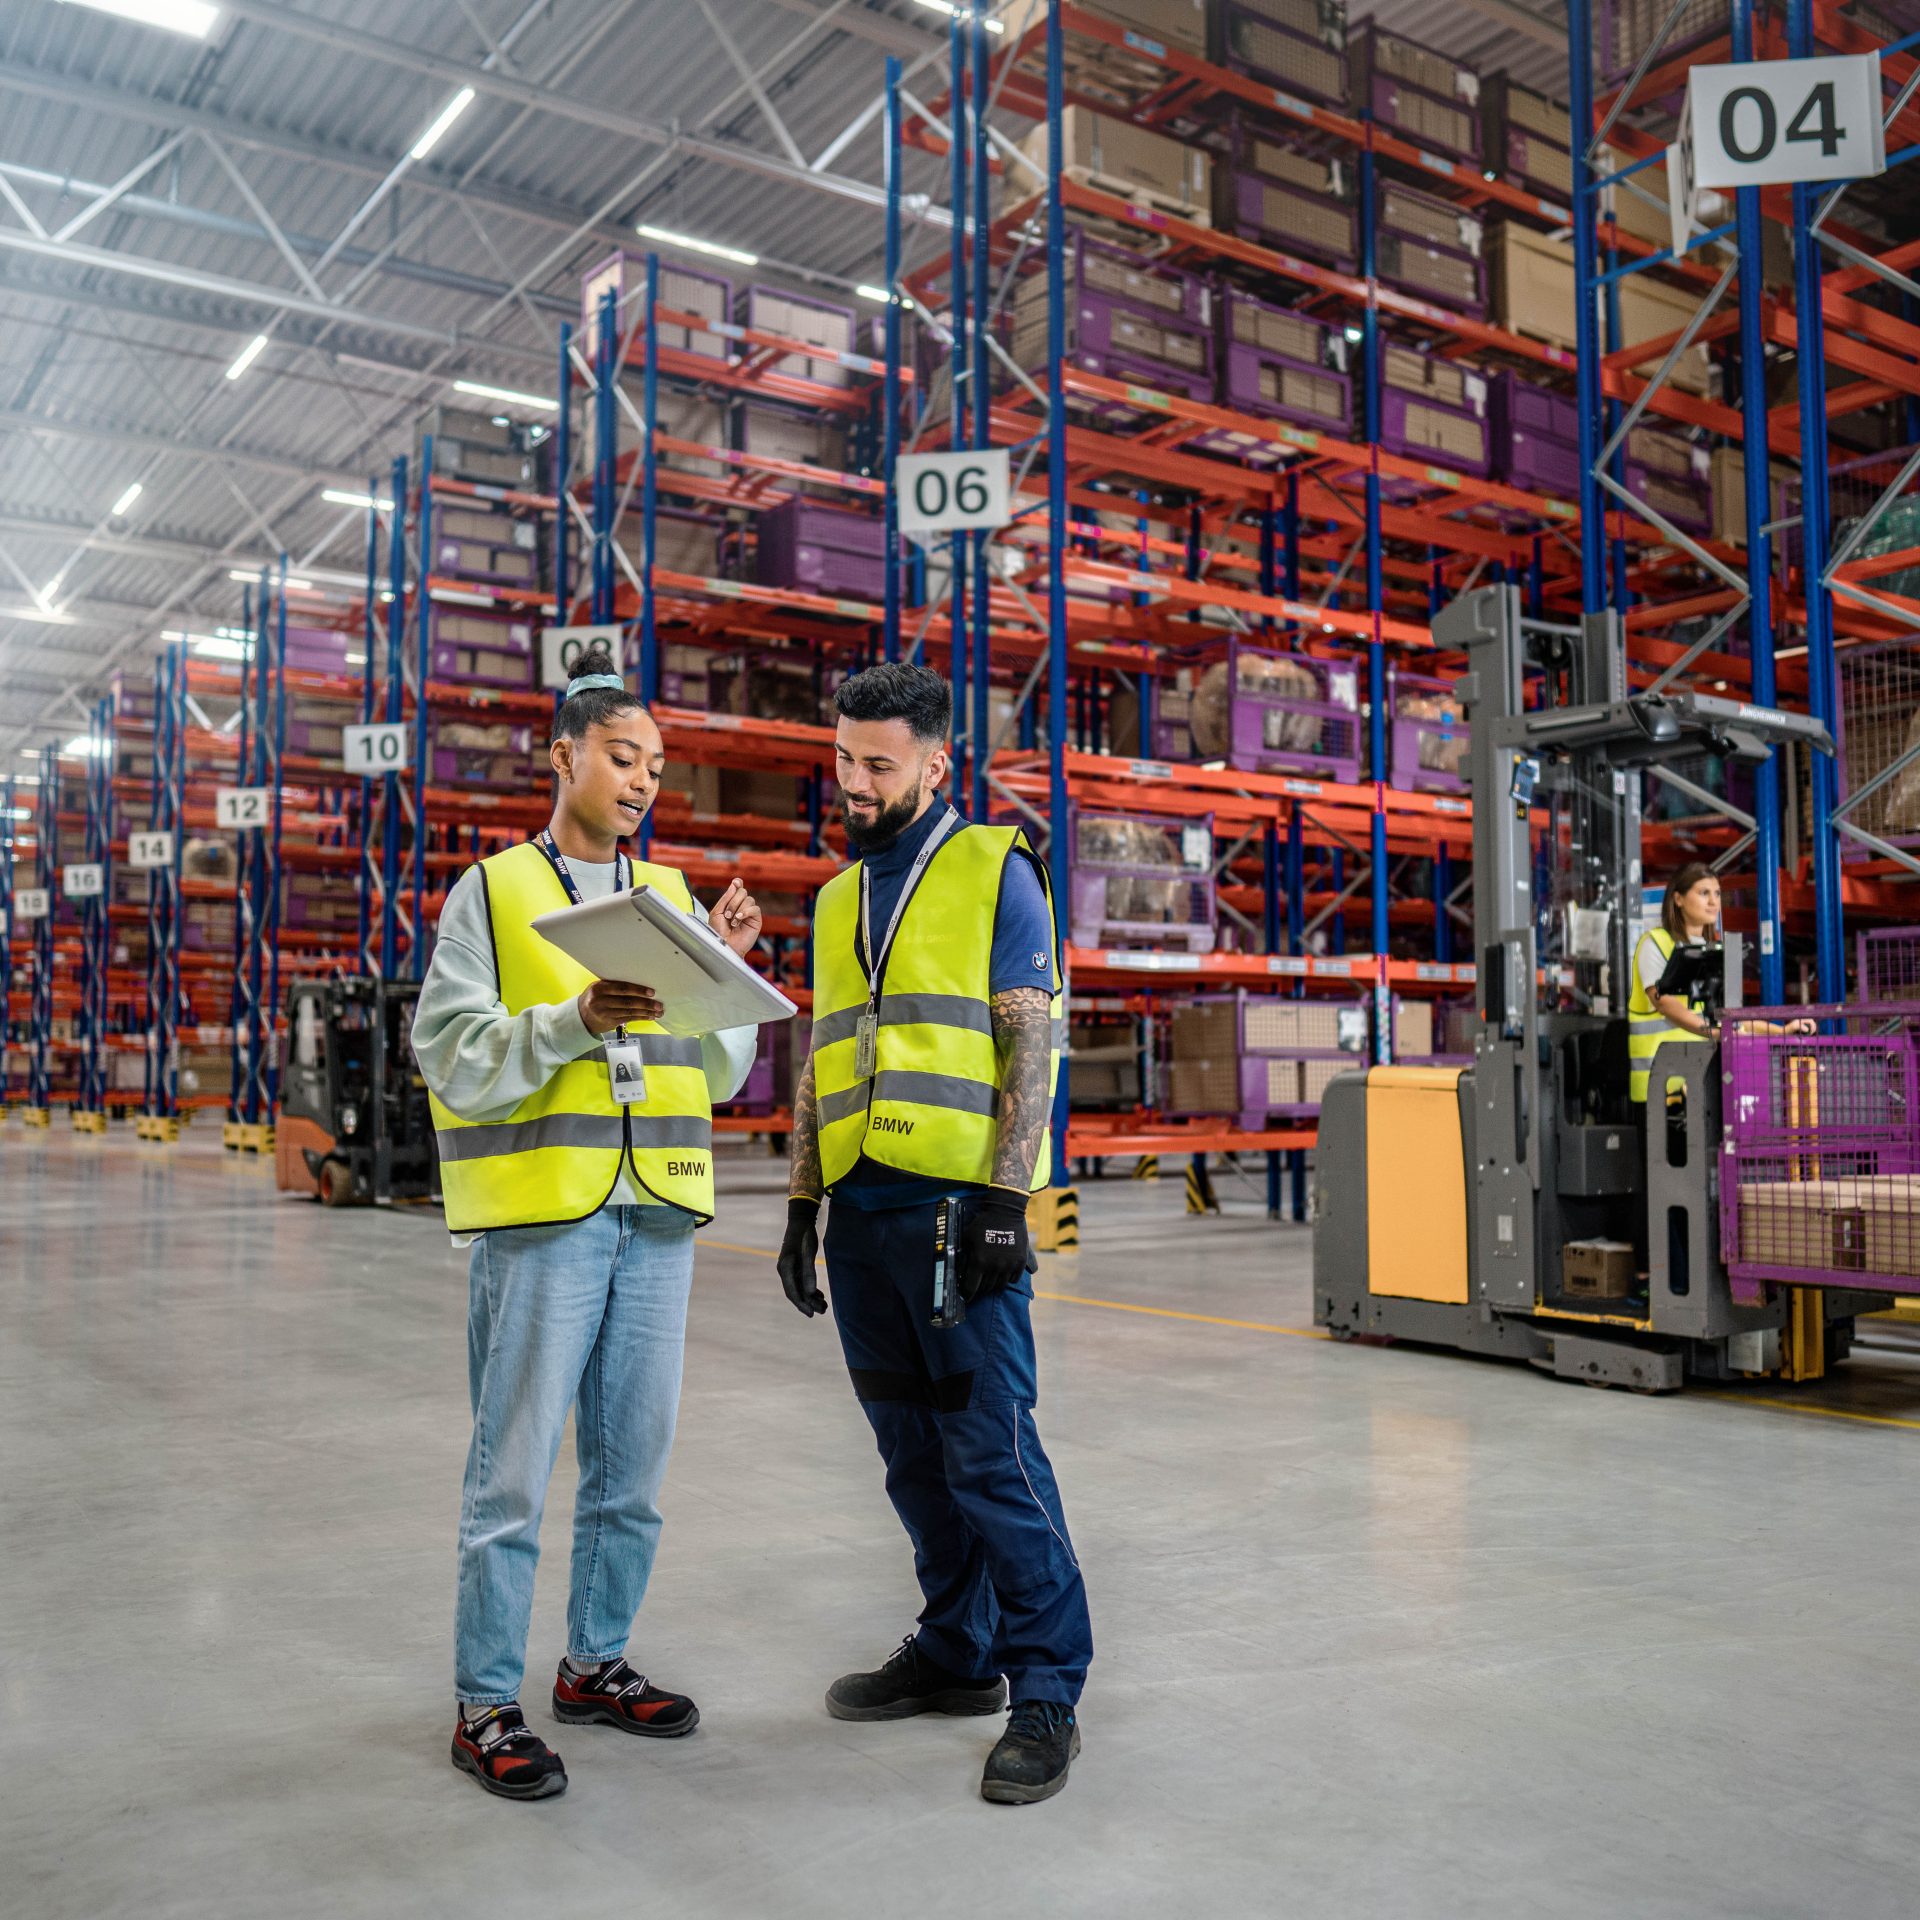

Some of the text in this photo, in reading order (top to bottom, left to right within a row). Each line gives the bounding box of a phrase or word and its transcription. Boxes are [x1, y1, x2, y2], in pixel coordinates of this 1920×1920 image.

[1719, 82, 1846, 163] 04
[915, 467, 988, 517] 06
[360, 733, 399, 762] 10
[227, 795, 259, 820] 12
[138, 839, 164, 860] 14
[555, 857, 569, 875] BMW
[72, 873, 96, 888] 16
[872, 1116, 915, 1136] BMW
[667, 1161, 706, 1177] BMW
